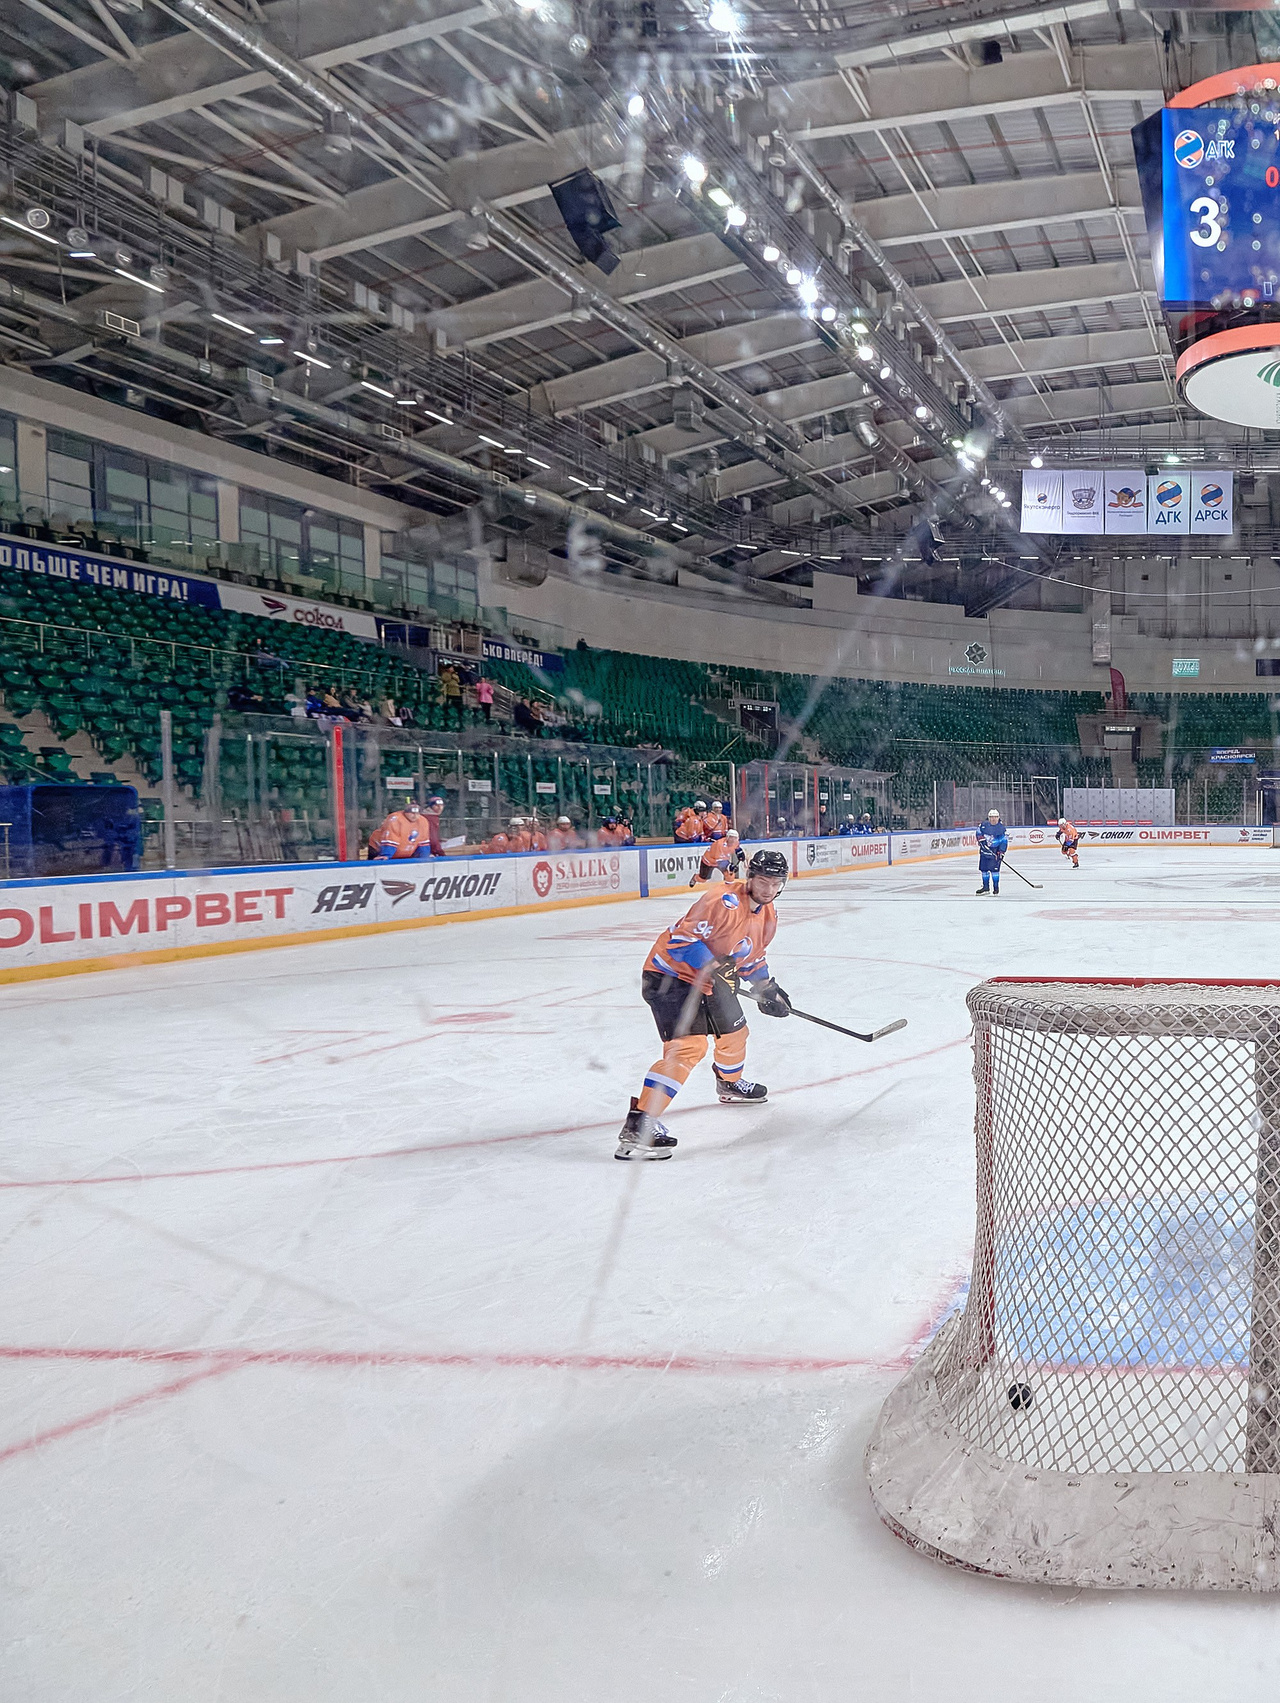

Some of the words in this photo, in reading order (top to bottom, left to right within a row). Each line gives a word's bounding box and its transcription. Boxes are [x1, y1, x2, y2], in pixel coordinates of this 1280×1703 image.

[1205, 140, 1236, 161] ДГК
[1189, 196, 1222, 247] 3
[1156, 511, 1182, 525] ДГК
[1195, 510, 1228, 522] ДРСК
[86, 563, 129, 589] ЧЕМ
[133, 572, 189, 600] ИГРА!
[1100, 831, 1133, 839] СОКОЛ!
[1138, 830, 1211, 840] OLIMPBET
[851, 843, 887, 857] OLIMPBET
[555, 858, 608, 880] SALEK
[655, 857, 684, 873] IKON
[419, 872, 502, 902] СОКОЛ!
[0, 887, 294, 949] OLIMPBET
[693, 920, 714, 939] 96
